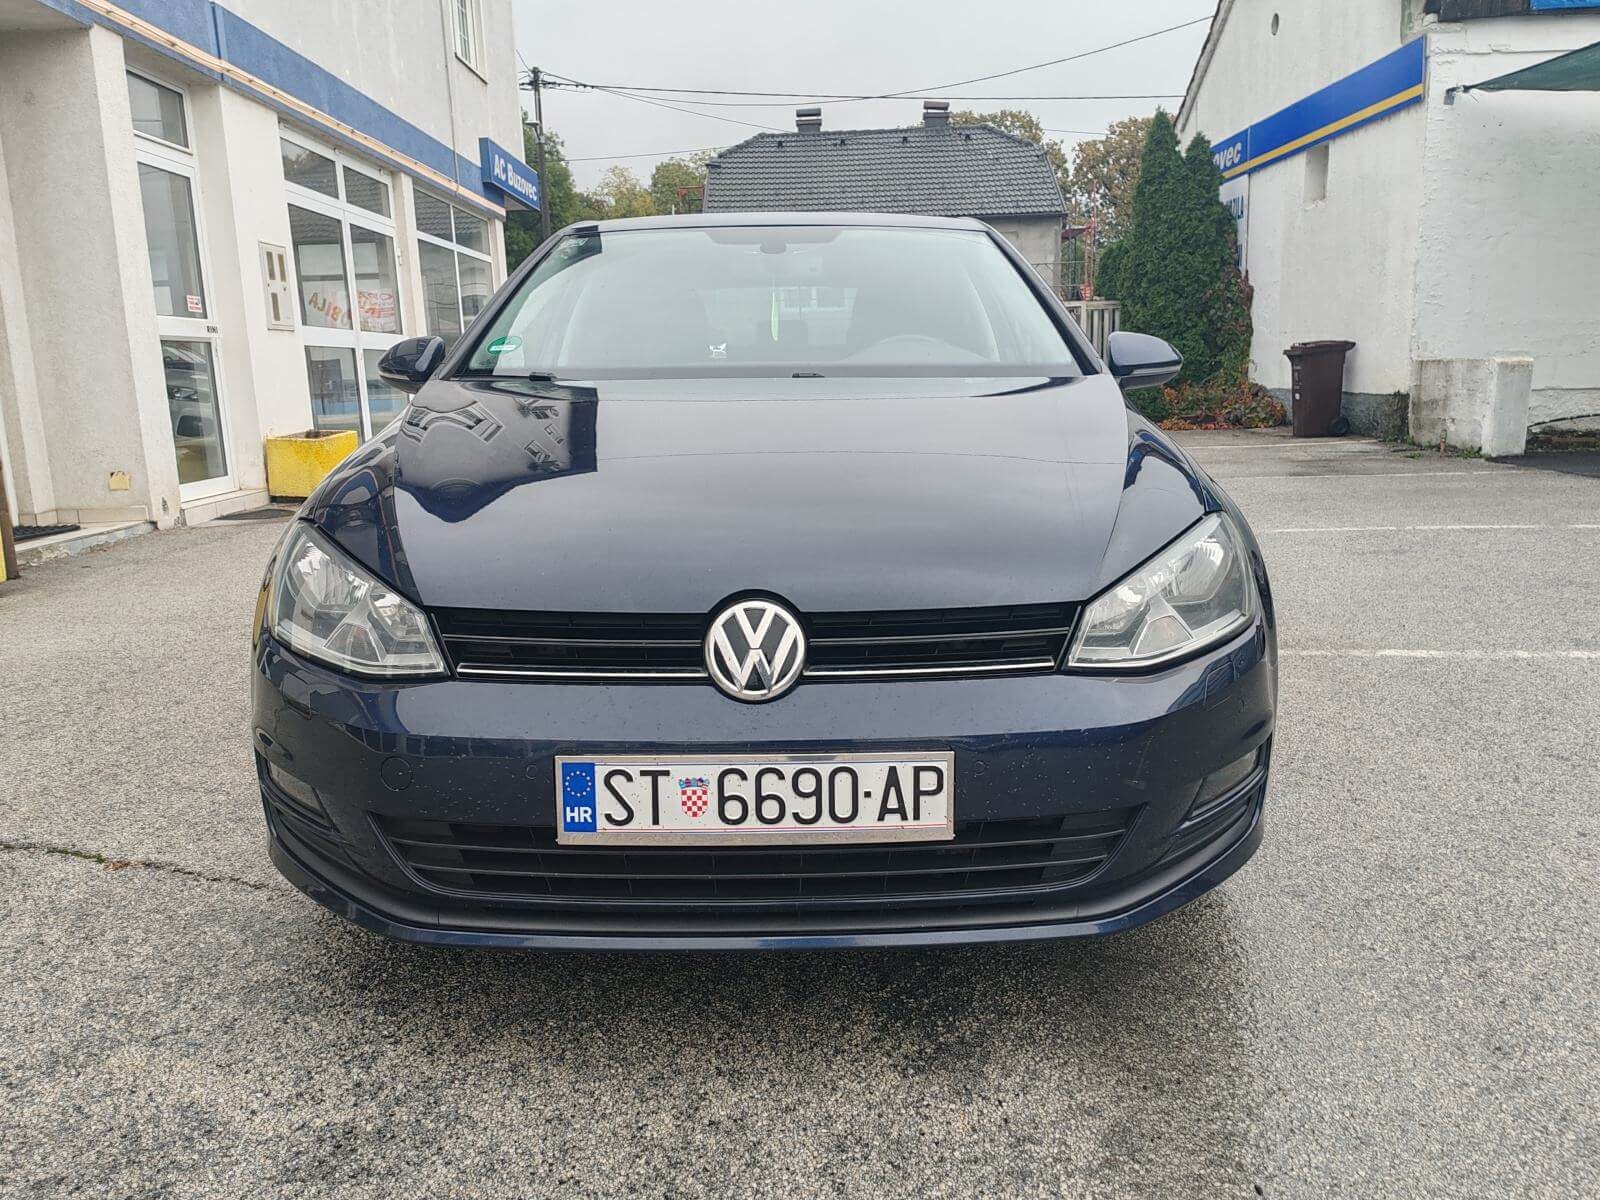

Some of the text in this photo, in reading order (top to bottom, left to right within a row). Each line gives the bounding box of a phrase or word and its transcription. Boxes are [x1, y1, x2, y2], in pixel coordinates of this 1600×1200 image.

[494, 153, 537, 202] AC Buzovec
[566, 806, 593, 823] HR
[603, 768, 670, 826] ST
